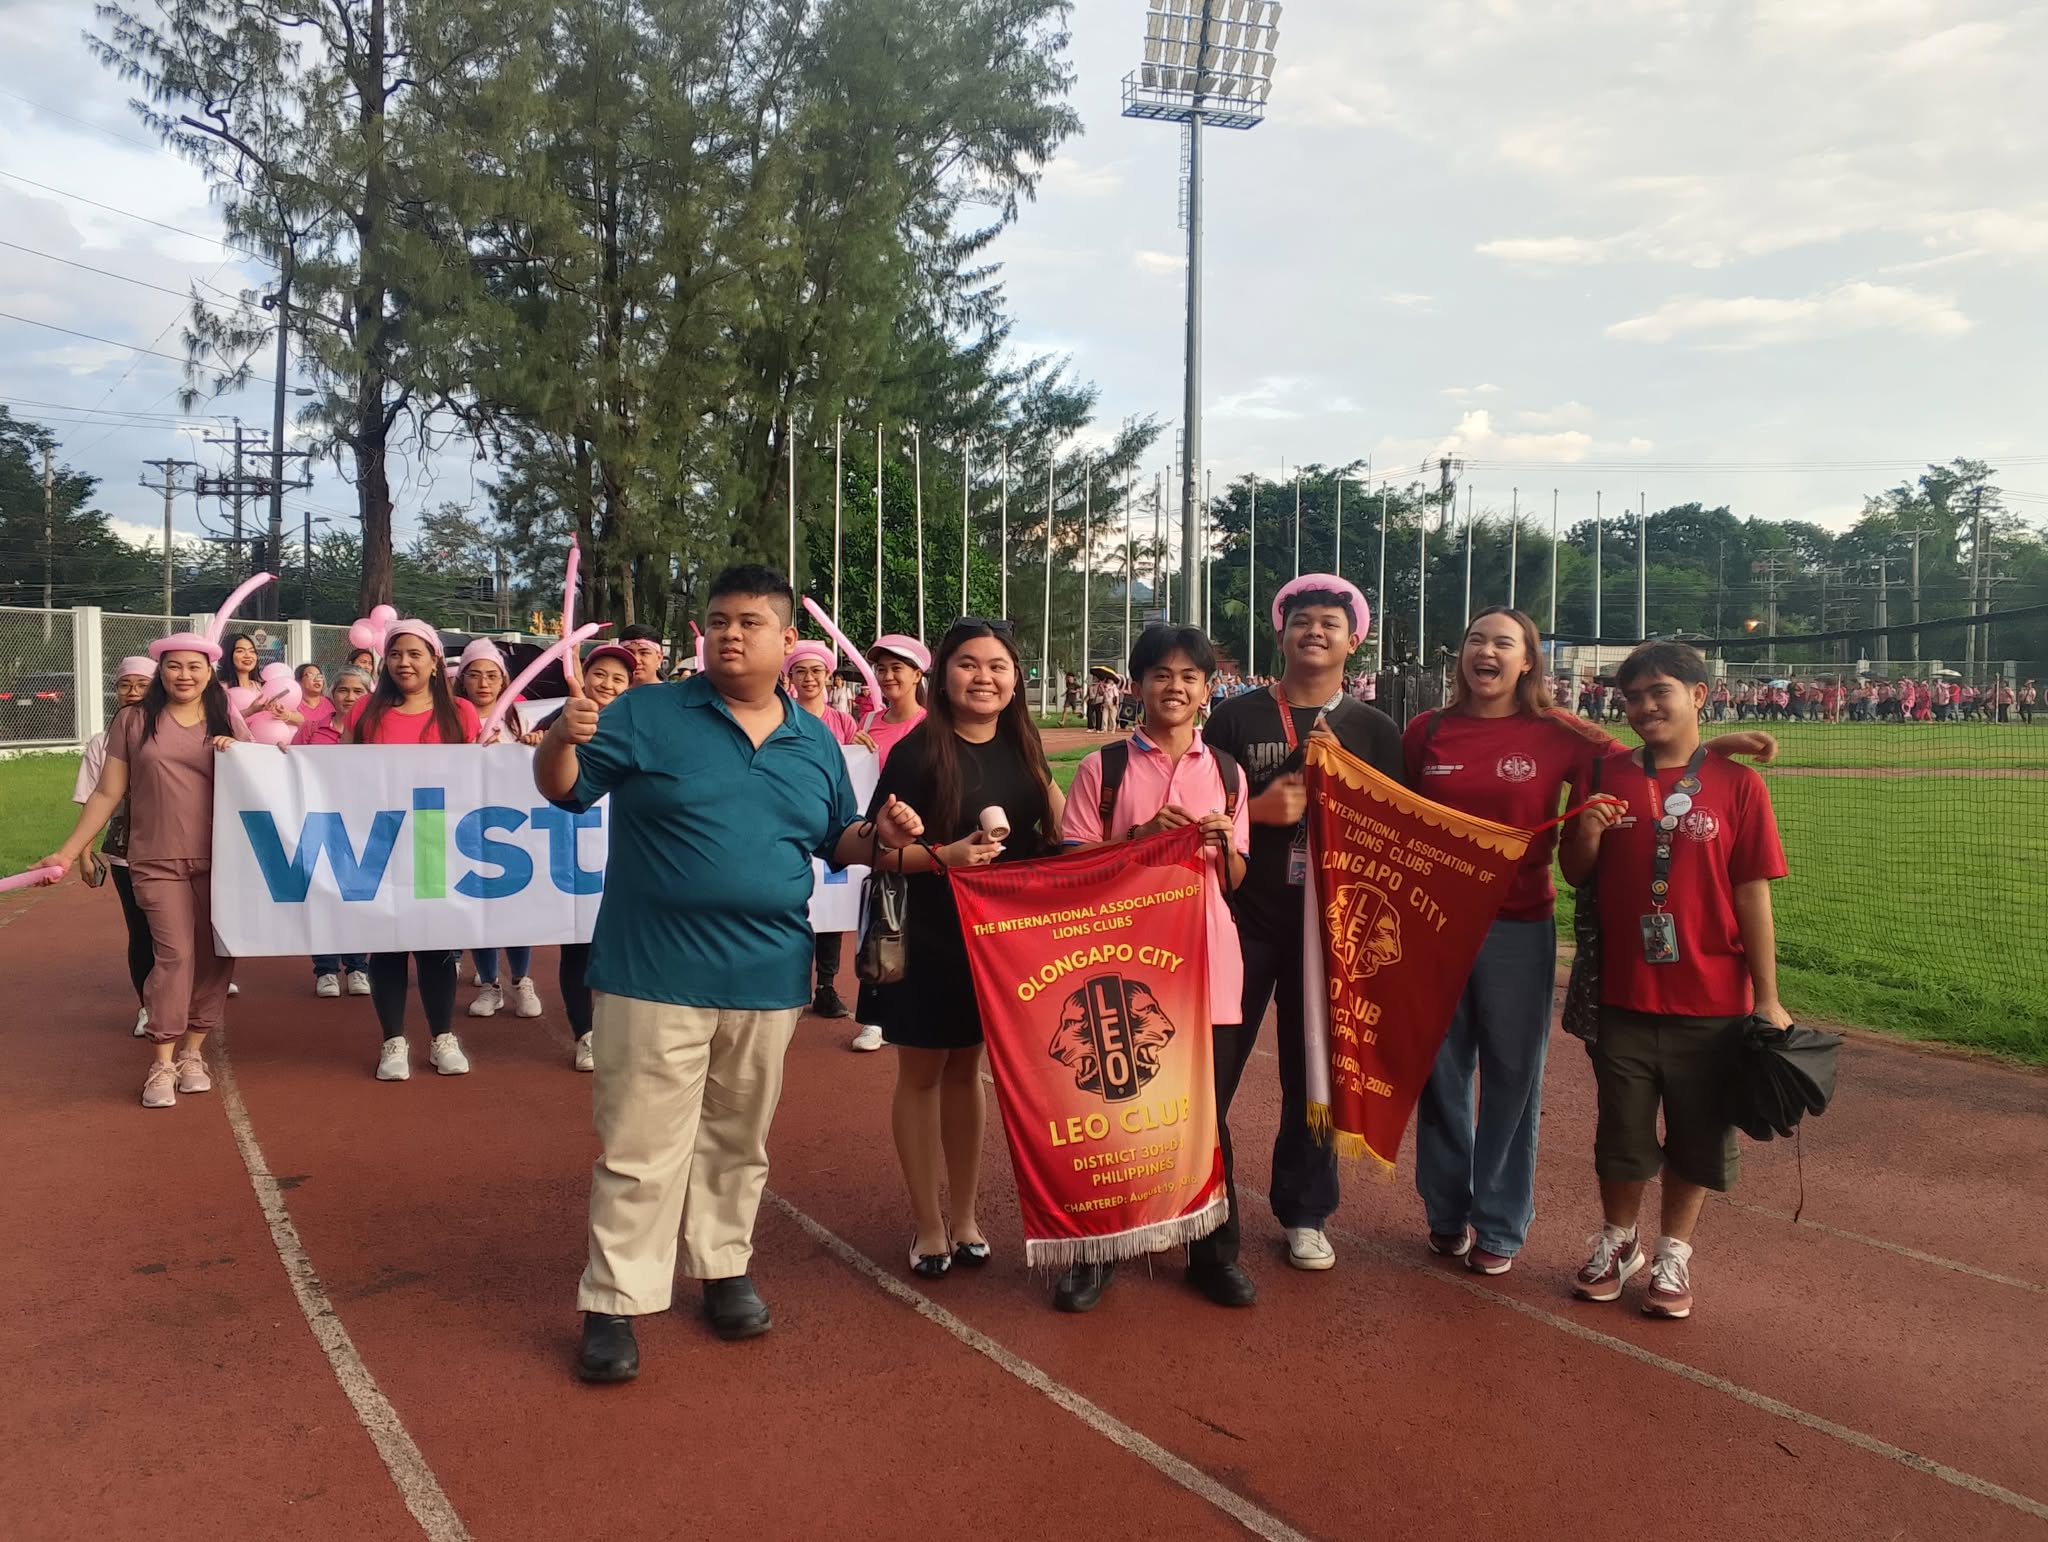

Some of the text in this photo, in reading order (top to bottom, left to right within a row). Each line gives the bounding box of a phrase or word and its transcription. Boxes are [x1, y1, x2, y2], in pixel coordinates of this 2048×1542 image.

[1345, 824, 1434, 876] LIONS CLUBS
[1407, 838, 1475, 877] ASSOCIATION
[1479, 870, 1496, 884] OF
[973, 884, 1201, 936] THE INTERNATIONAL ASSOCIATION OF
[1321, 851, 1448, 933] LONGAPO CITY
[1052, 915, 1133, 940] LIONS CLUBS
[1344, 893, 1369, 965] LEO
[1017, 943, 1185, 1001] OLONGAPO CITY
[1095, 984, 1129, 1086] LEO
[1050, 1113, 1110, 1146] LEO
[1073, 1136, 1184, 1171] DISTRICT 301-D1
[1092, 1158, 1175, 1186] PHILIPPINES
[1064, 1195, 1128, 1213] CHARTERED:
